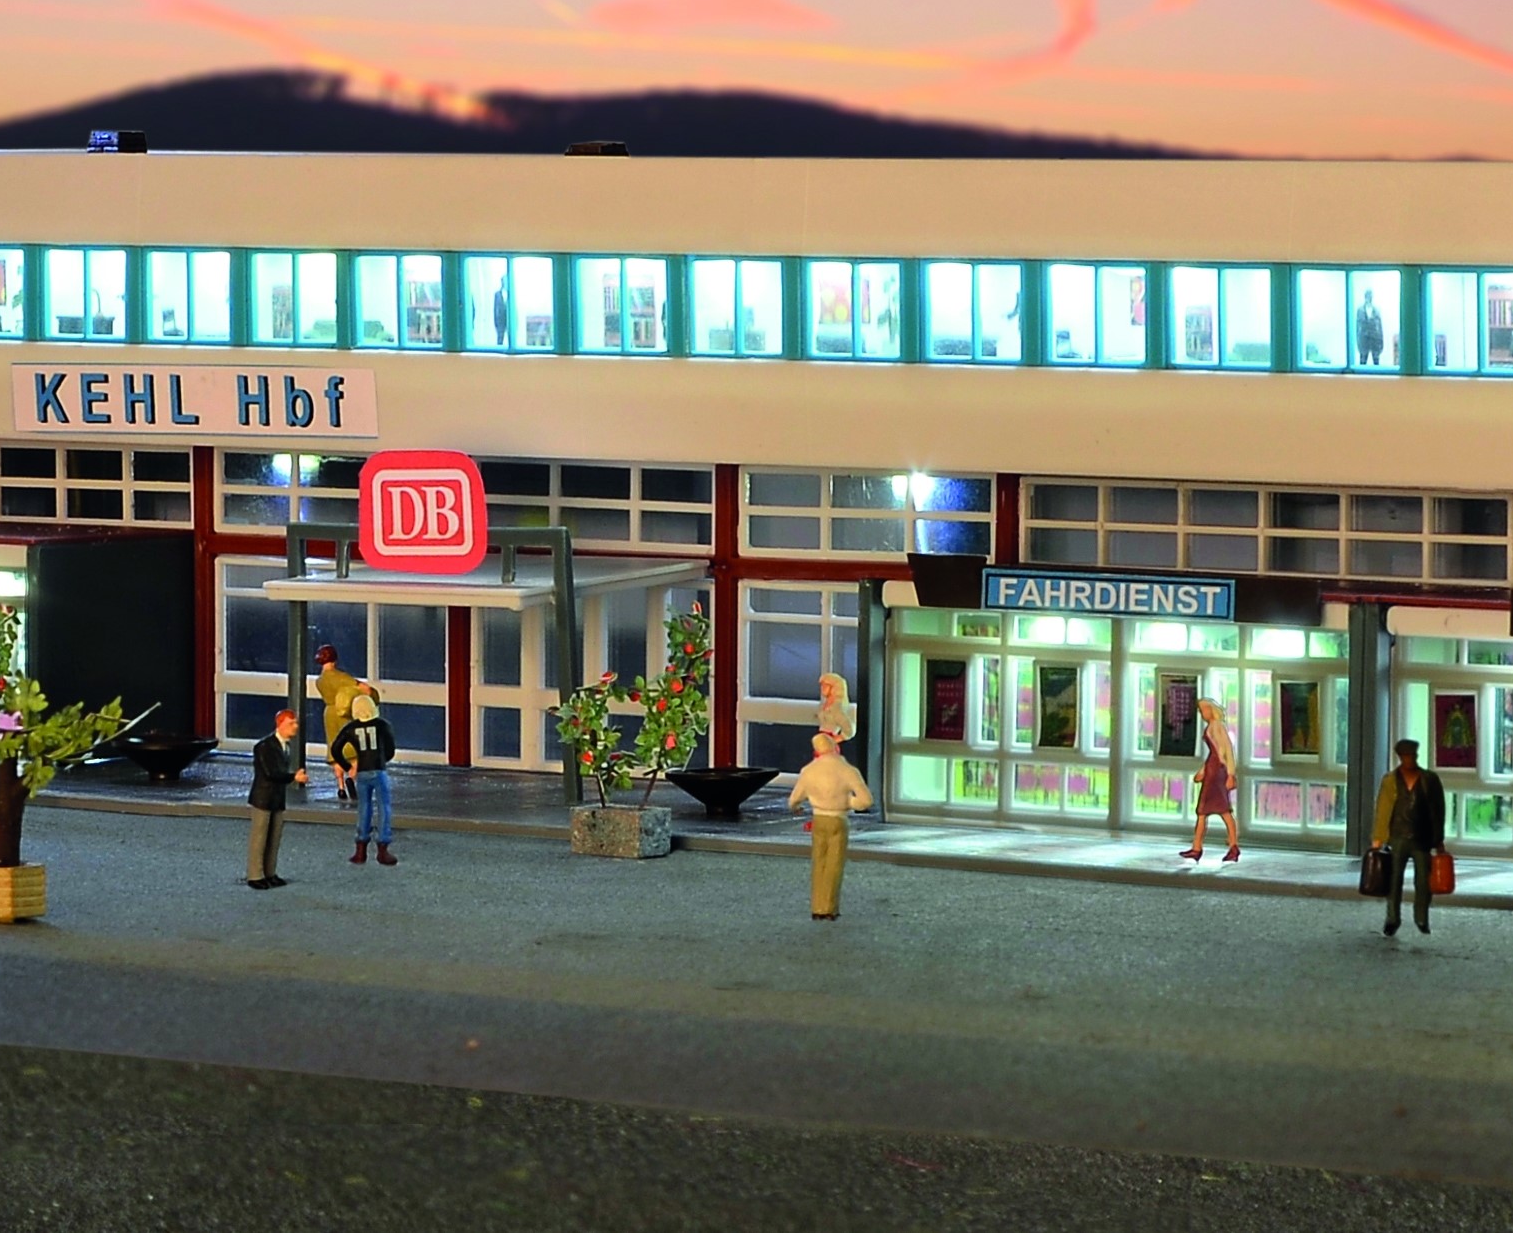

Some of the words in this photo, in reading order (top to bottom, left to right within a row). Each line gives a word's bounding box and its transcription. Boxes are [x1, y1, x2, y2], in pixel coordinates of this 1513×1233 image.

[33, 372, 200, 425] KEHL
[236, 374, 345, 428] Hbf
[387, 486, 460, 540] DB
[998, 577, 1221, 615] FAHRDIENST
[354, 726, 378, 751] 11
